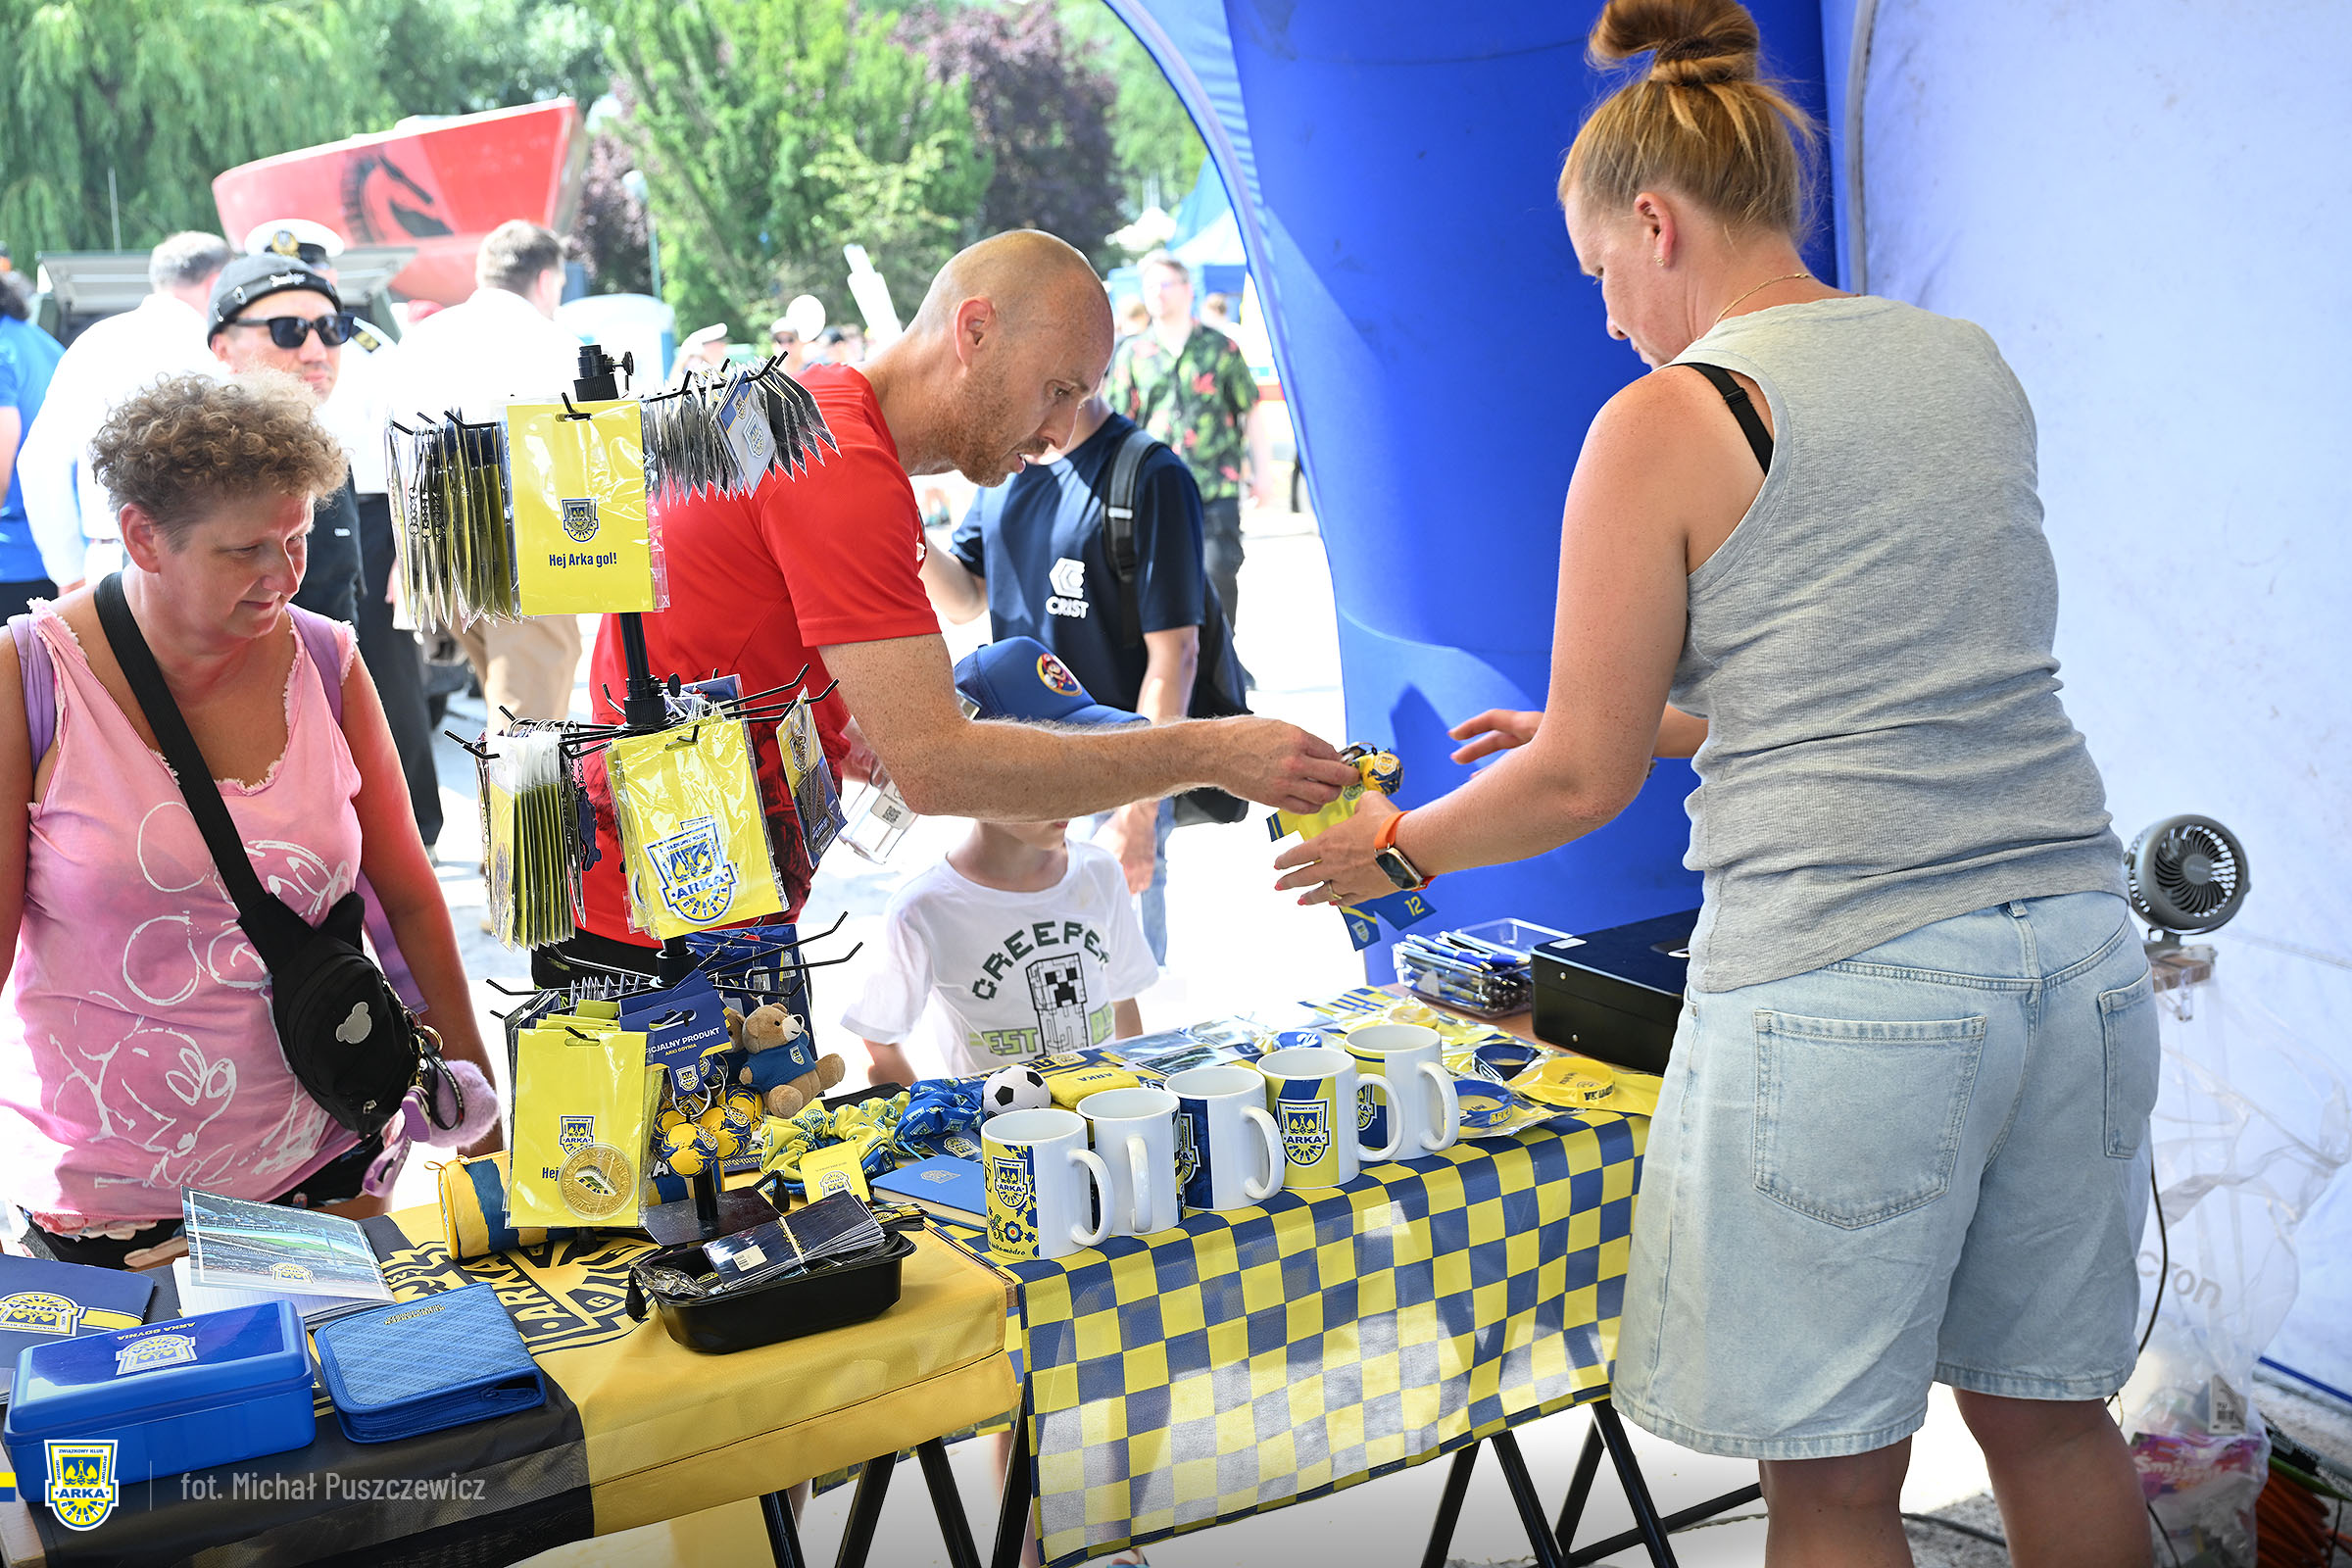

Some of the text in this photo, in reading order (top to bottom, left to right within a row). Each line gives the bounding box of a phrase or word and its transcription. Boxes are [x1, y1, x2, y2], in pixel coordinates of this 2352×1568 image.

[549, 551, 617, 569] Hej Arka gol!
[1045, 596, 1090, 619] CRIST
[677, 873, 726, 900] ARKA
[1403, 896, 1426, 917] 12
[682, 1027, 720, 1044] PRODUKT
[1077, 1072, 1114, 1082] ARKA
[542, 1166, 560, 1182] Hej
[998, 1183, 1023, 1193] ARKA
[460, 1253, 573, 1323] ARKA
[117, 1321, 196, 1341] ARKA GDYNIA
